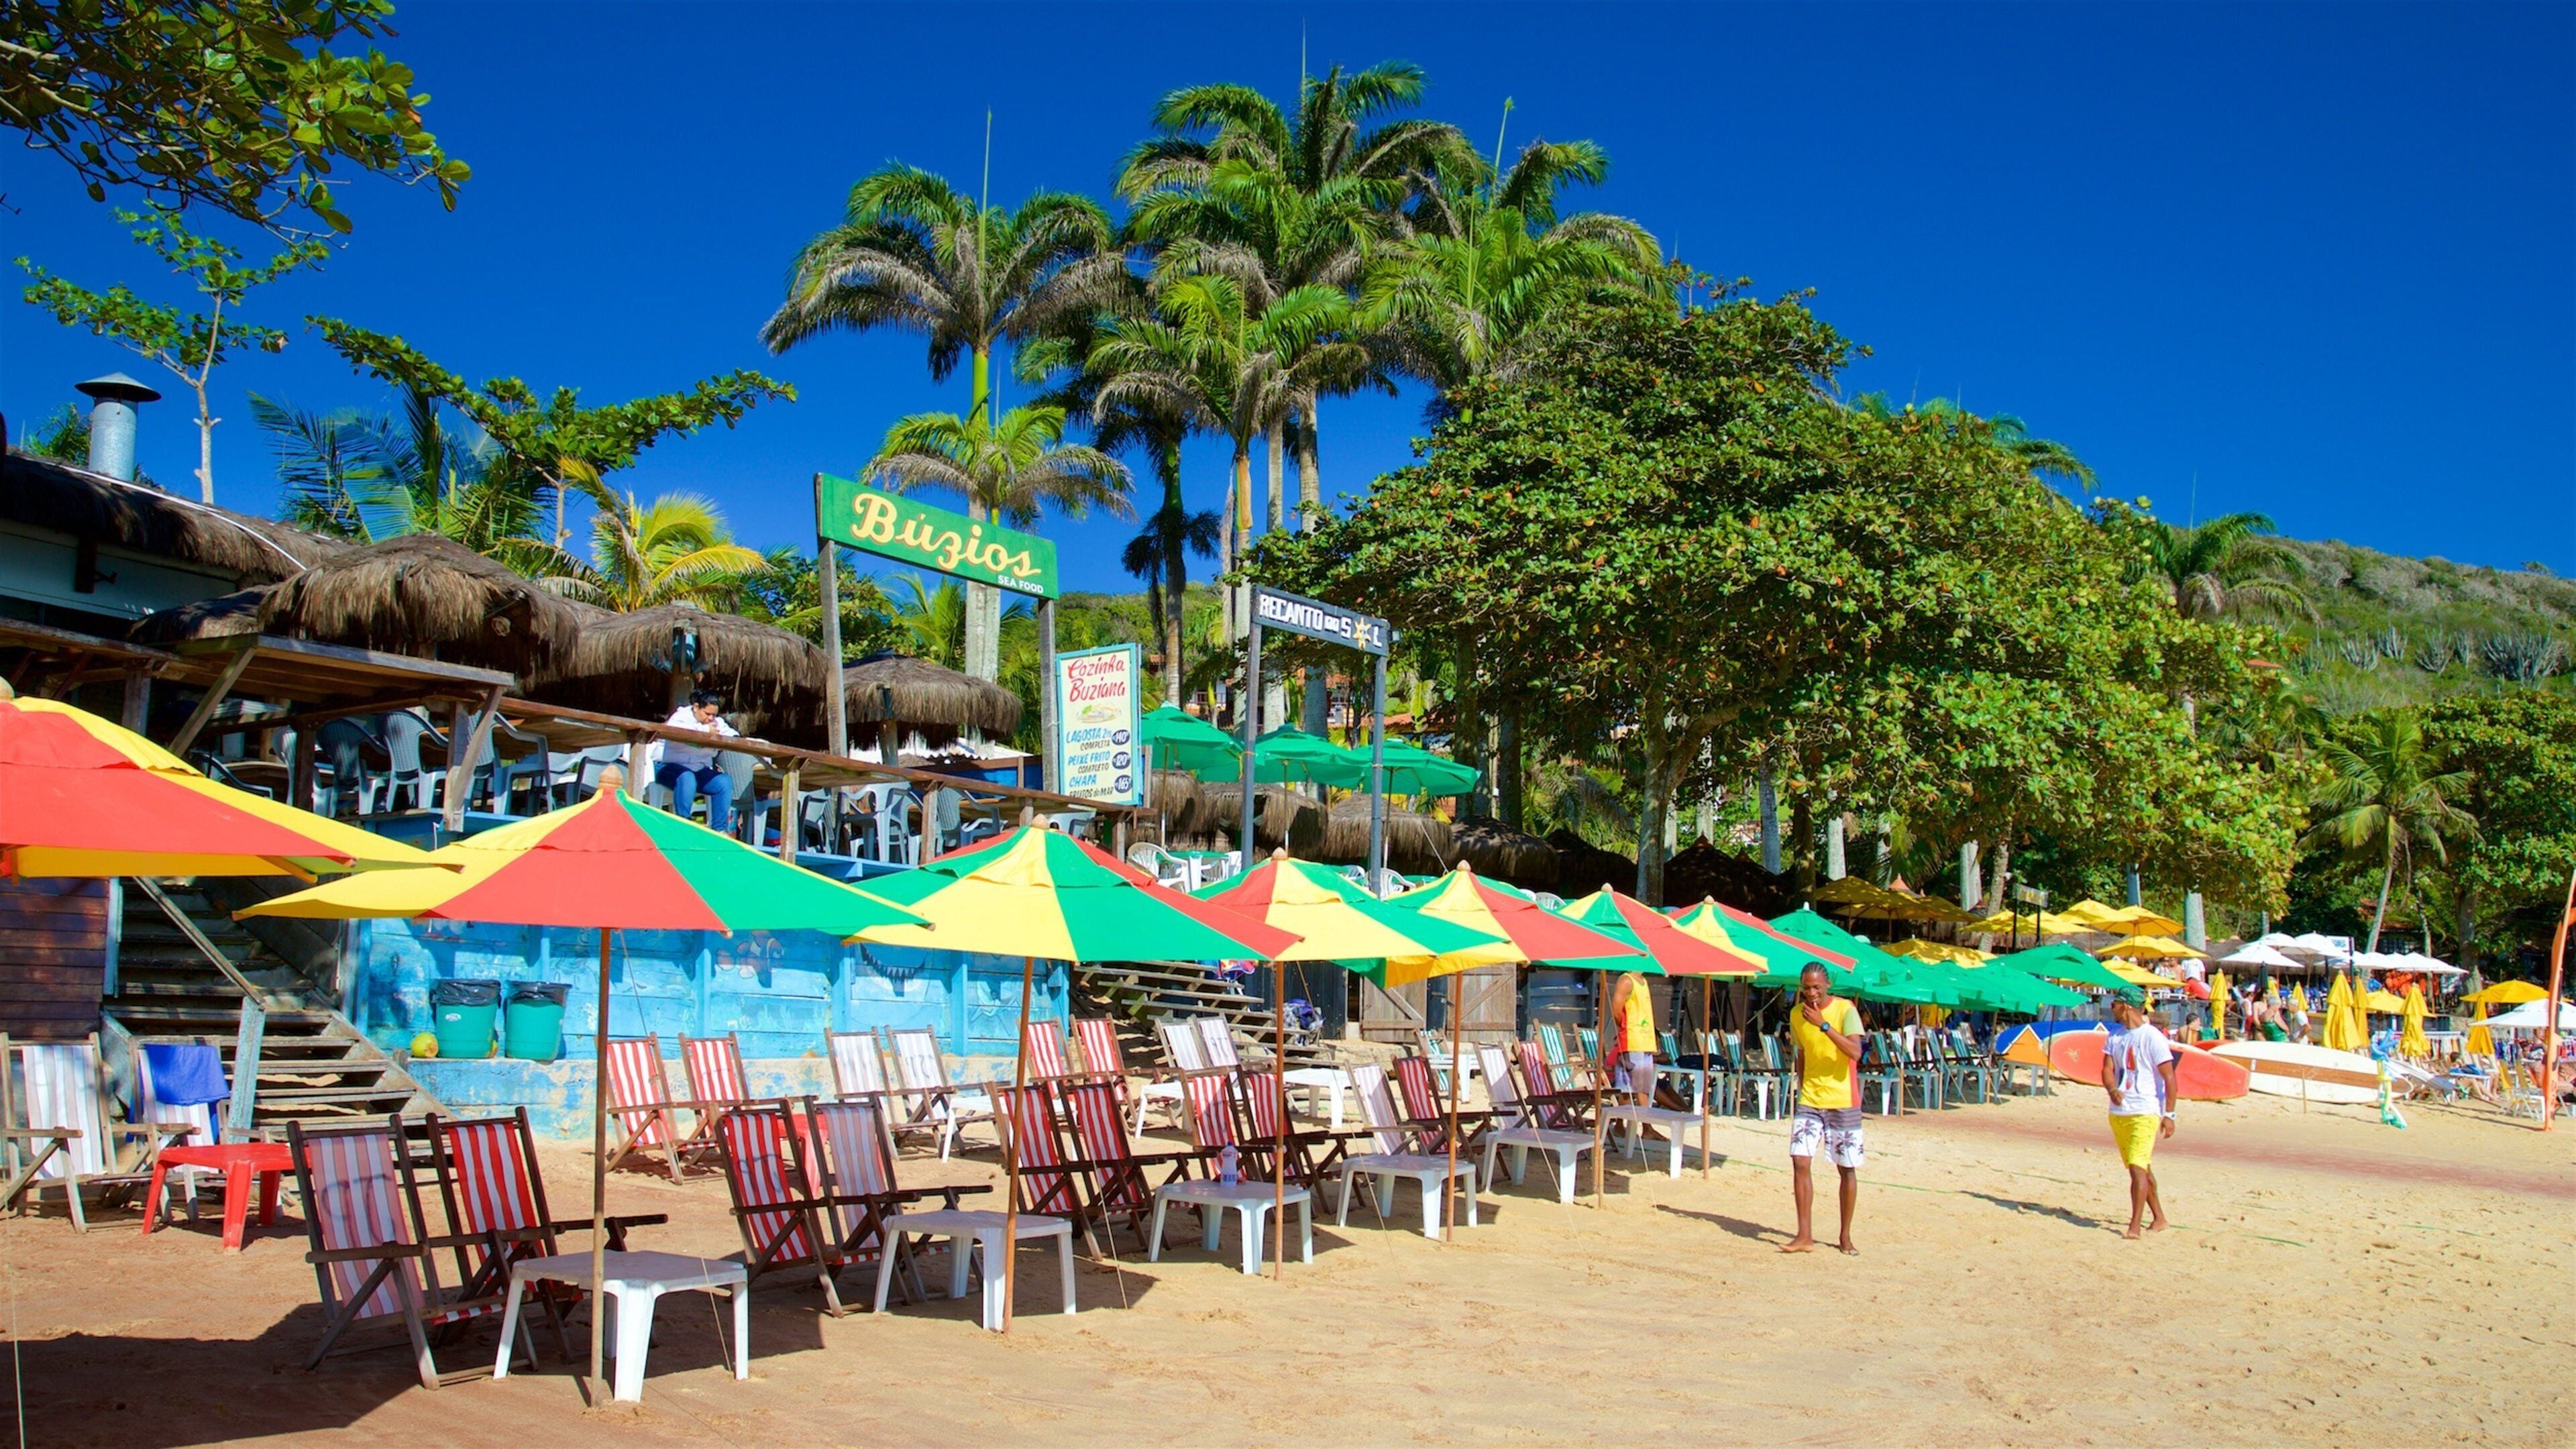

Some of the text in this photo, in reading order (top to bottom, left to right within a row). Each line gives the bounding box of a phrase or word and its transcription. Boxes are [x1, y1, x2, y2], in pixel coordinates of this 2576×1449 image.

[851, 492, 1042, 578] Búzios
[998, 574, 1044, 594] SEA FOOD
[1259, 594, 1324, 631] RECANTO
[1340, 616, 1382, 648] SL
[1069, 677, 1125, 702] Buziana
[1066, 728, 1102, 743] LAGOSTA
[1081, 740, 1110, 751] COMPLETA
[1068, 751, 1111, 765] PEIXE FRITO
[1078, 763, 1109, 773] COMPLETO
[1069, 774, 1097, 787] CHAPA
